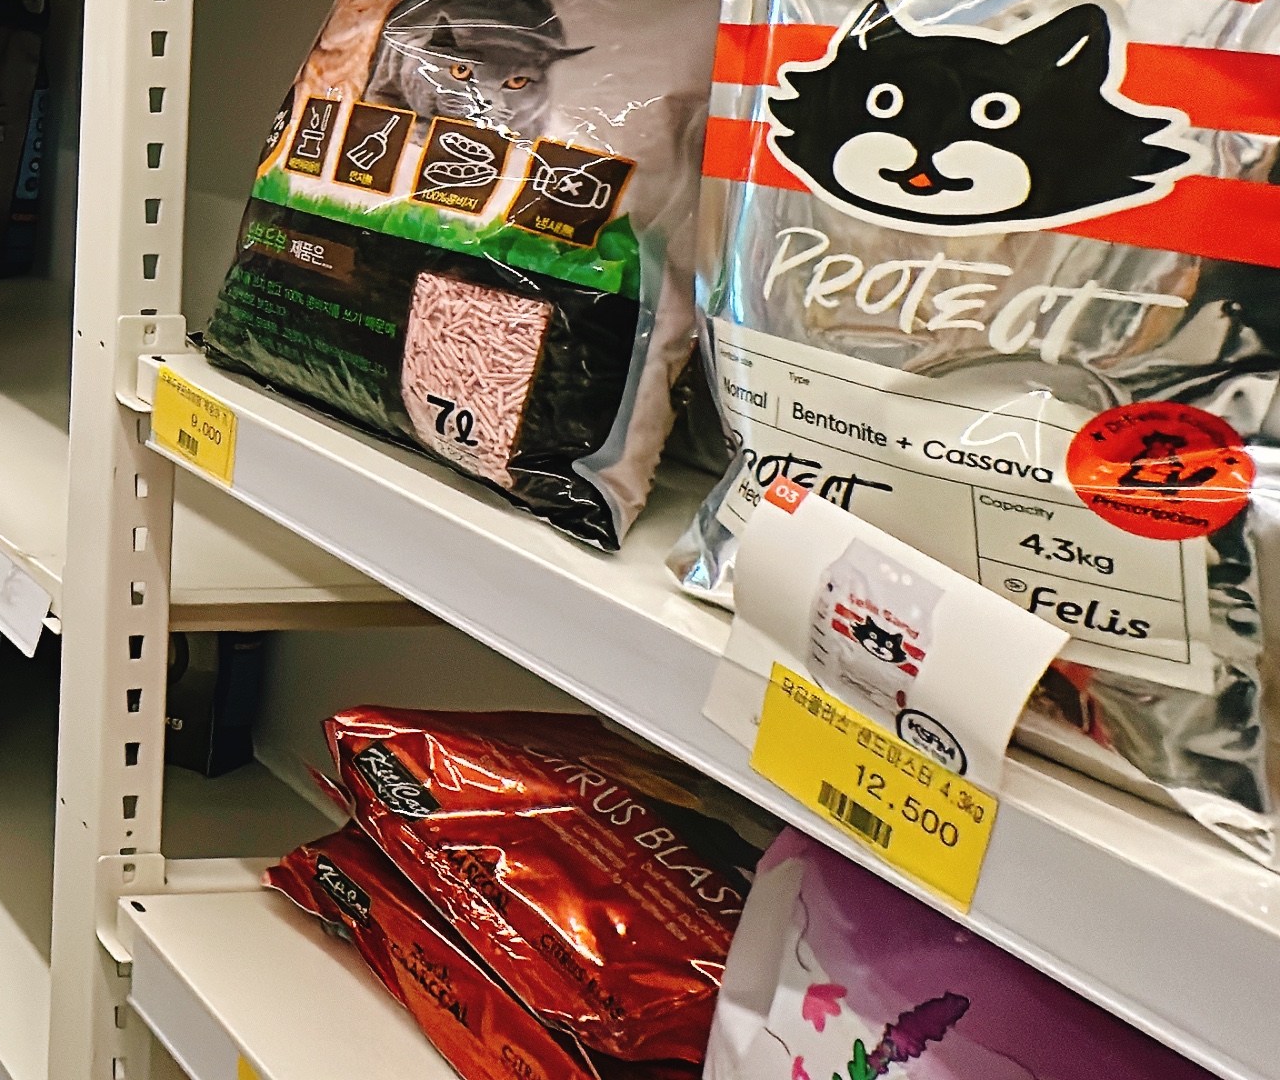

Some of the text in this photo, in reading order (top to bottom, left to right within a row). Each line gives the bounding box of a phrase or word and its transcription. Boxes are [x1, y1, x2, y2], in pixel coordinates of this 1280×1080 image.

[763, 225, 1189, 360] PROTECT
[723, 376, 767, 409] Normal
[789, 371, 811, 386] Type
[792, 401, 888, 447] Bentonite
[922, 439, 1054, 486] Cassava
[775, 484, 800, 504] 03
[978, 493, 1055, 521] Capacity
[1019, 532, 1115, 575] 4.3kg
